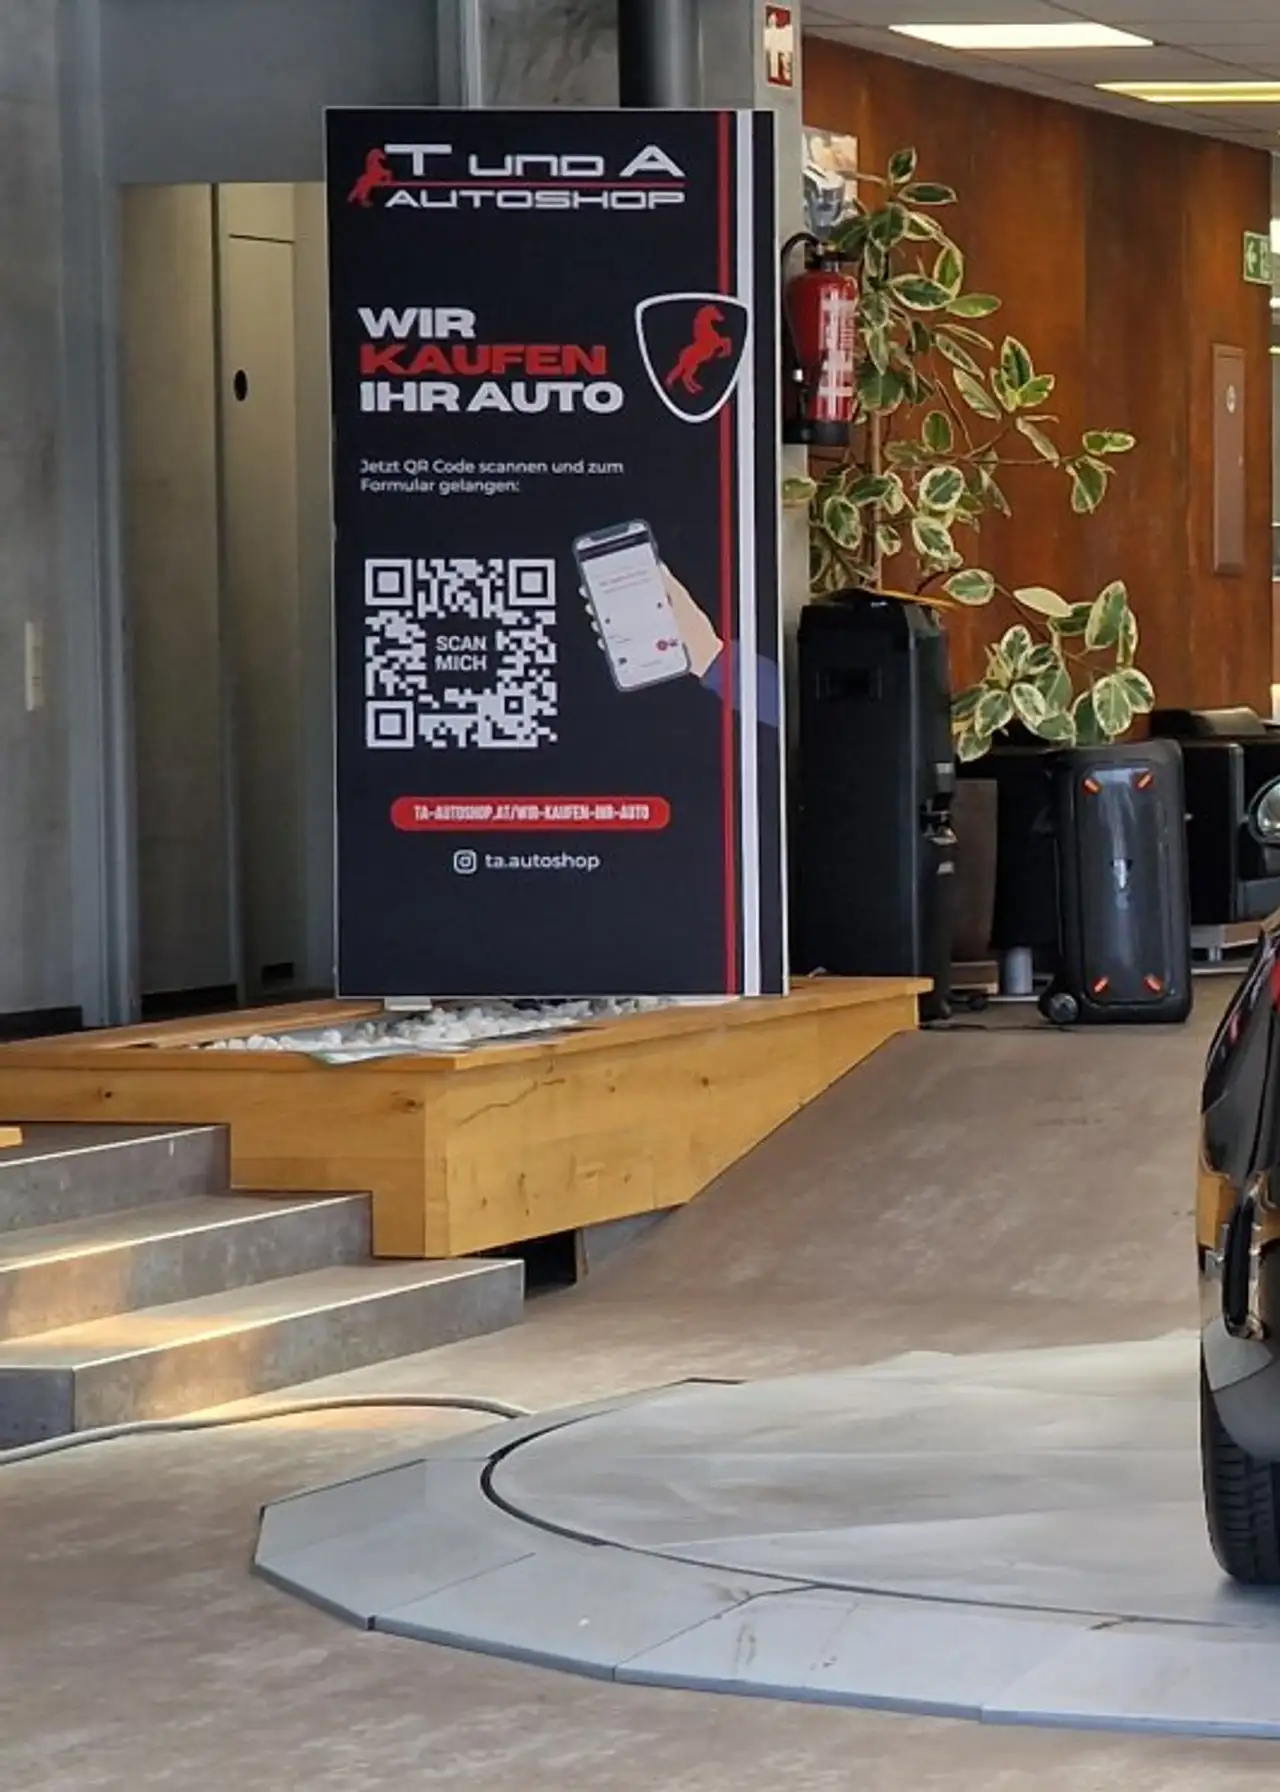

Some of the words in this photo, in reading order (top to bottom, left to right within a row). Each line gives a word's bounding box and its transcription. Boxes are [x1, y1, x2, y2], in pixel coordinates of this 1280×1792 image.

[384, 144, 452, 176] T
[619, 144, 685, 177] A
[385, 190, 685, 209] AUTOSHOP
[358, 307, 476, 338] WIR
[359, 345, 607, 374] KAUFEN
[360, 381, 461, 412] IHR
[466, 381, 624, 413] AUTO
[360, 458, 400, 474] Jetzt
[403, 458, 429, 475] QR
[432, 458, 475, 474] Code
[478, 461, 547, 474] scannen
[552, 458, 584, 474] und
[587, 462, 624, 474] zum
[360, 477, 435, 493] Formular
[439, 477, 520, 496] gelangen:
[436, 635, 487, 651] SCAN
[434, 654, 487, 671] MICH
[484, 852, 600, 871] ta.autoshop
